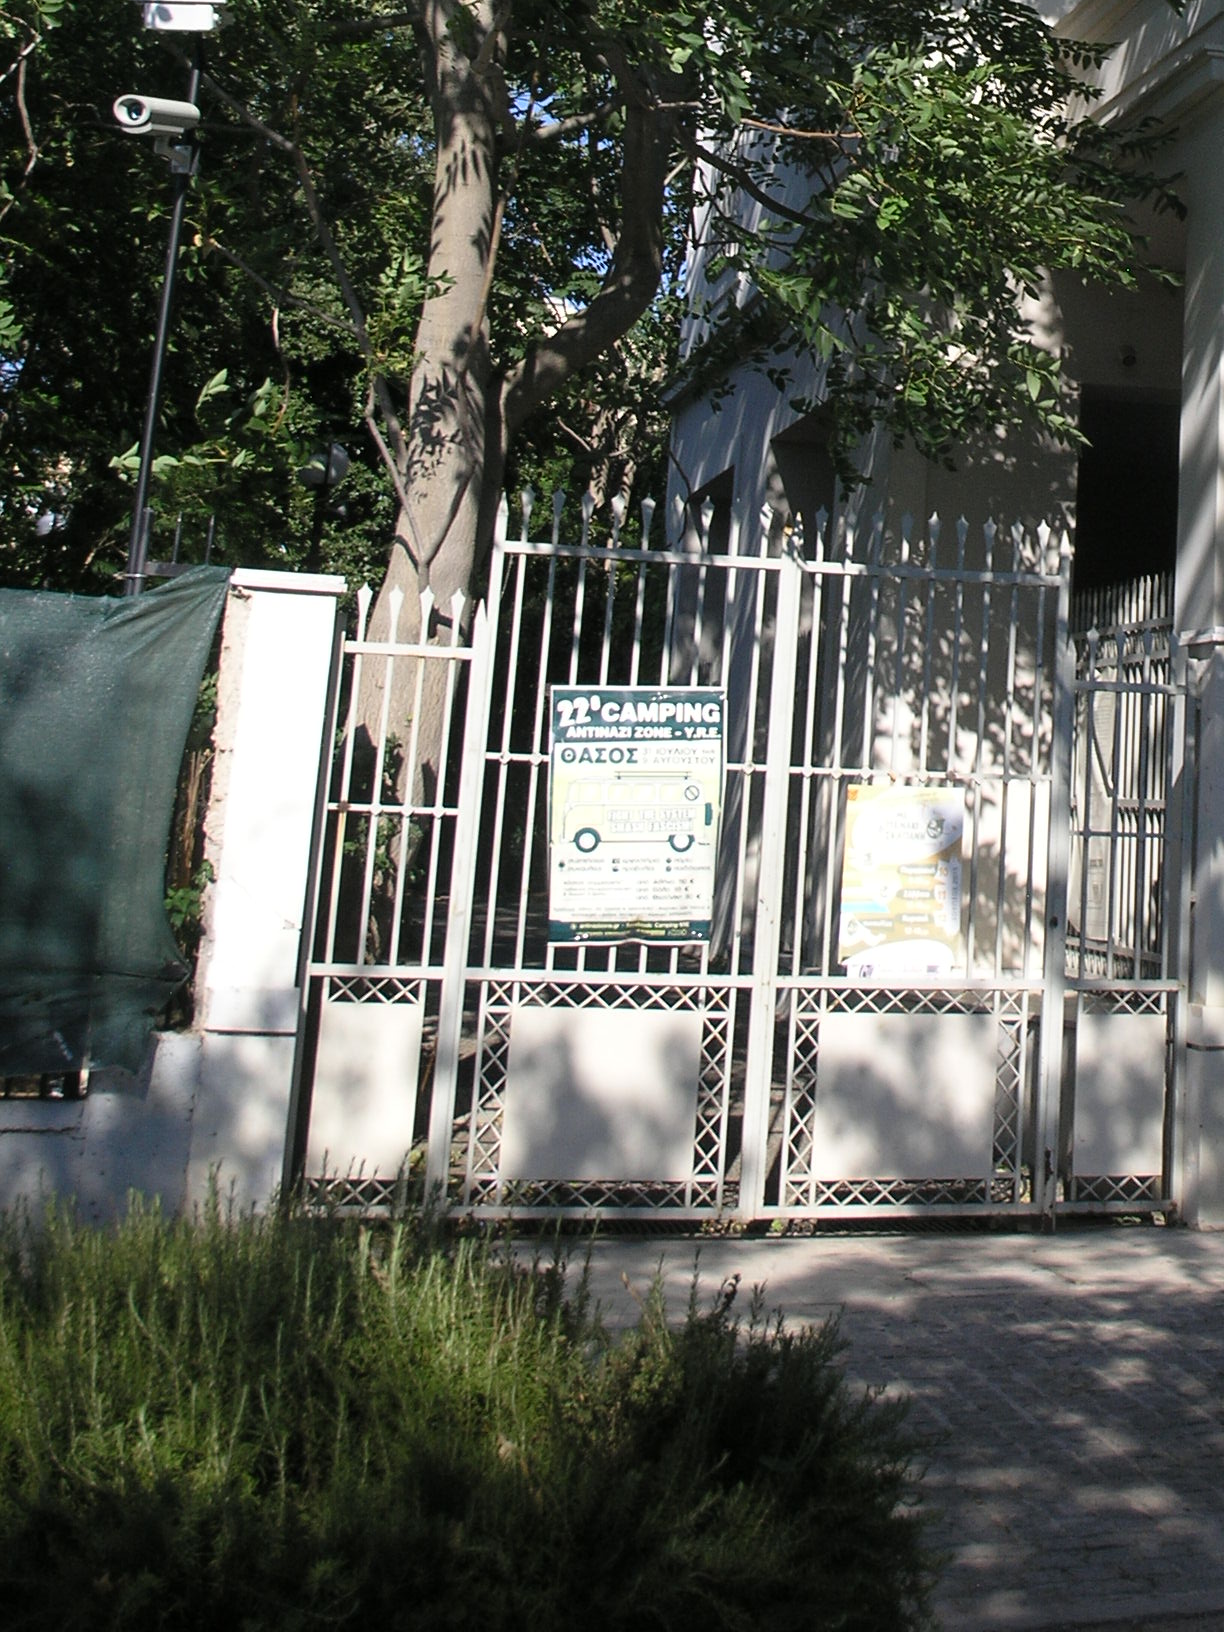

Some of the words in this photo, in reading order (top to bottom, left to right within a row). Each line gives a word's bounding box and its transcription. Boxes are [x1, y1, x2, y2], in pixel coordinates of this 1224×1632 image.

[602, 702, 720, 723] CAMPING
[566, 726, 632, 738] ANTINAZI
[634, 726, 673, 738] ZONE
[684, 726, 721, 738] Y.R.E.
[560, 747, 639, 764] ΘΑΣΟΣ
